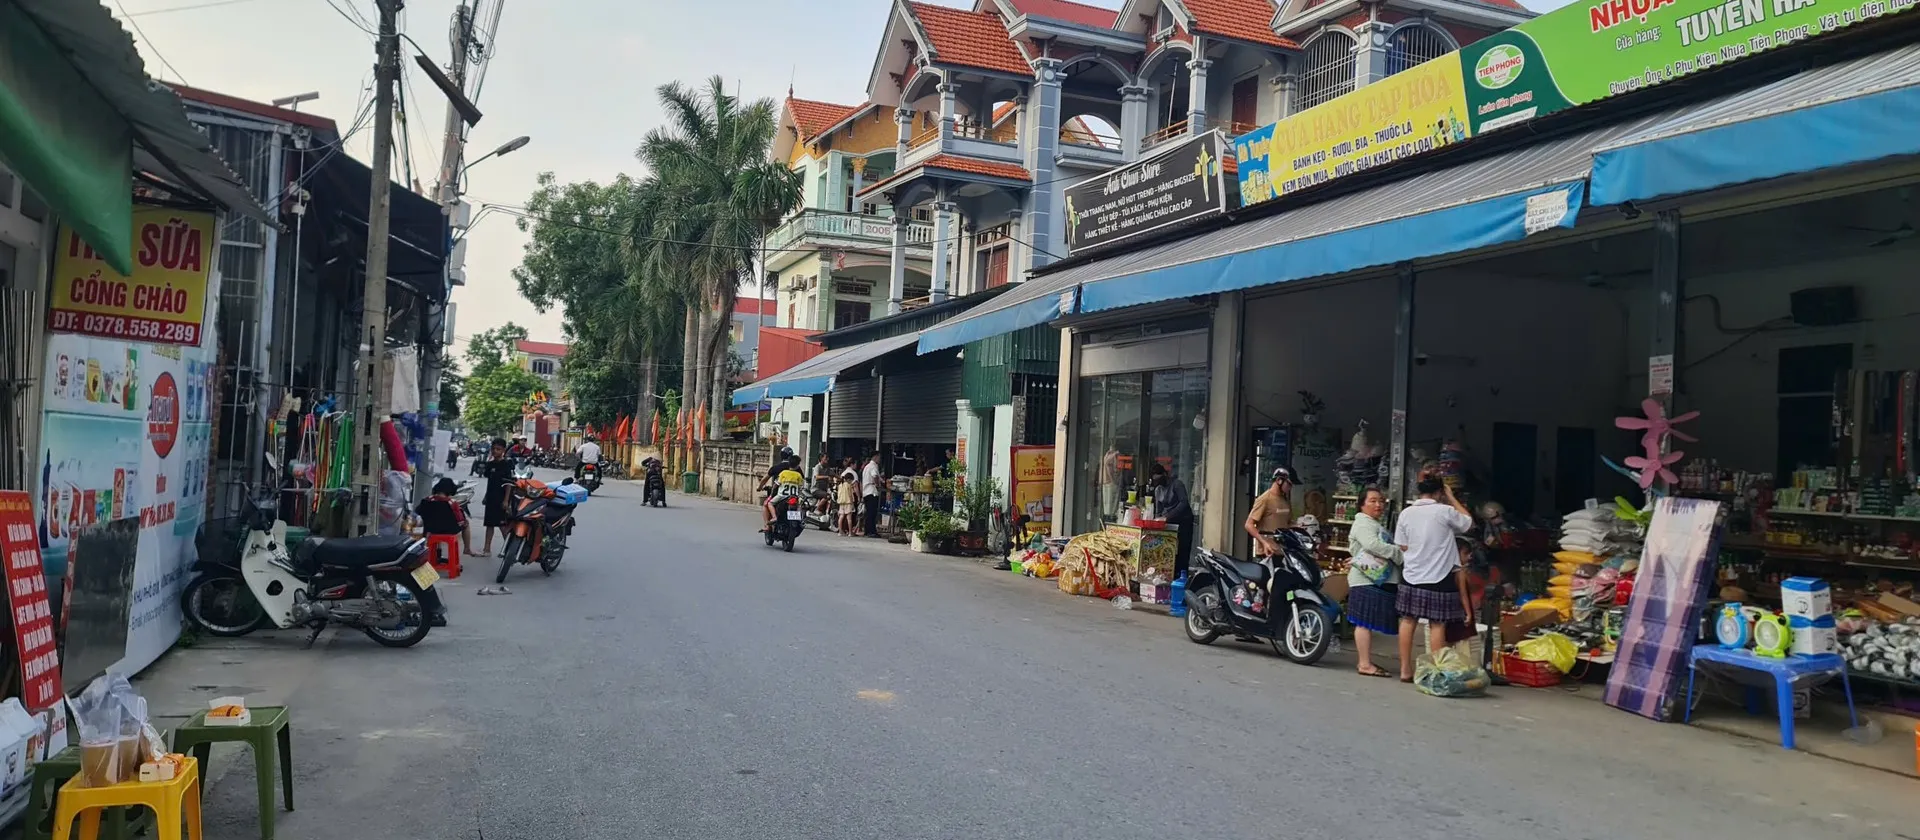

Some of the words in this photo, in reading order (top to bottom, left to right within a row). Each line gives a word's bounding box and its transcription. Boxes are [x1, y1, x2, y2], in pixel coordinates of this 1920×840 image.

[1665, 65, 1673, 77] &
[1774, 24, 1809, 43] Phong
[1495, 56, 1521, 71] PHONG
[1355, 136, 1368, 151] BIA
[1141, 163, 1160, 182] Store
[1089, 205, 1105, 216] TRANG
[1136, 188, 1154, 200] TREND
[1174, 173, 1196, 187] BIGSIZE
[1282, 180, 1297, 193] KEM
[1169, 202, 1180, 213] CAO
[138, 217, 201, 272] SỮA
[70, 269, 128, 309] CỔNG
[132, 282, 188, 315] CHÀO
[54, 310, 79, 331] ĐT:
[83, 313, 195, 343] 0378.558.289
[782, 484, 798, 497] 20
